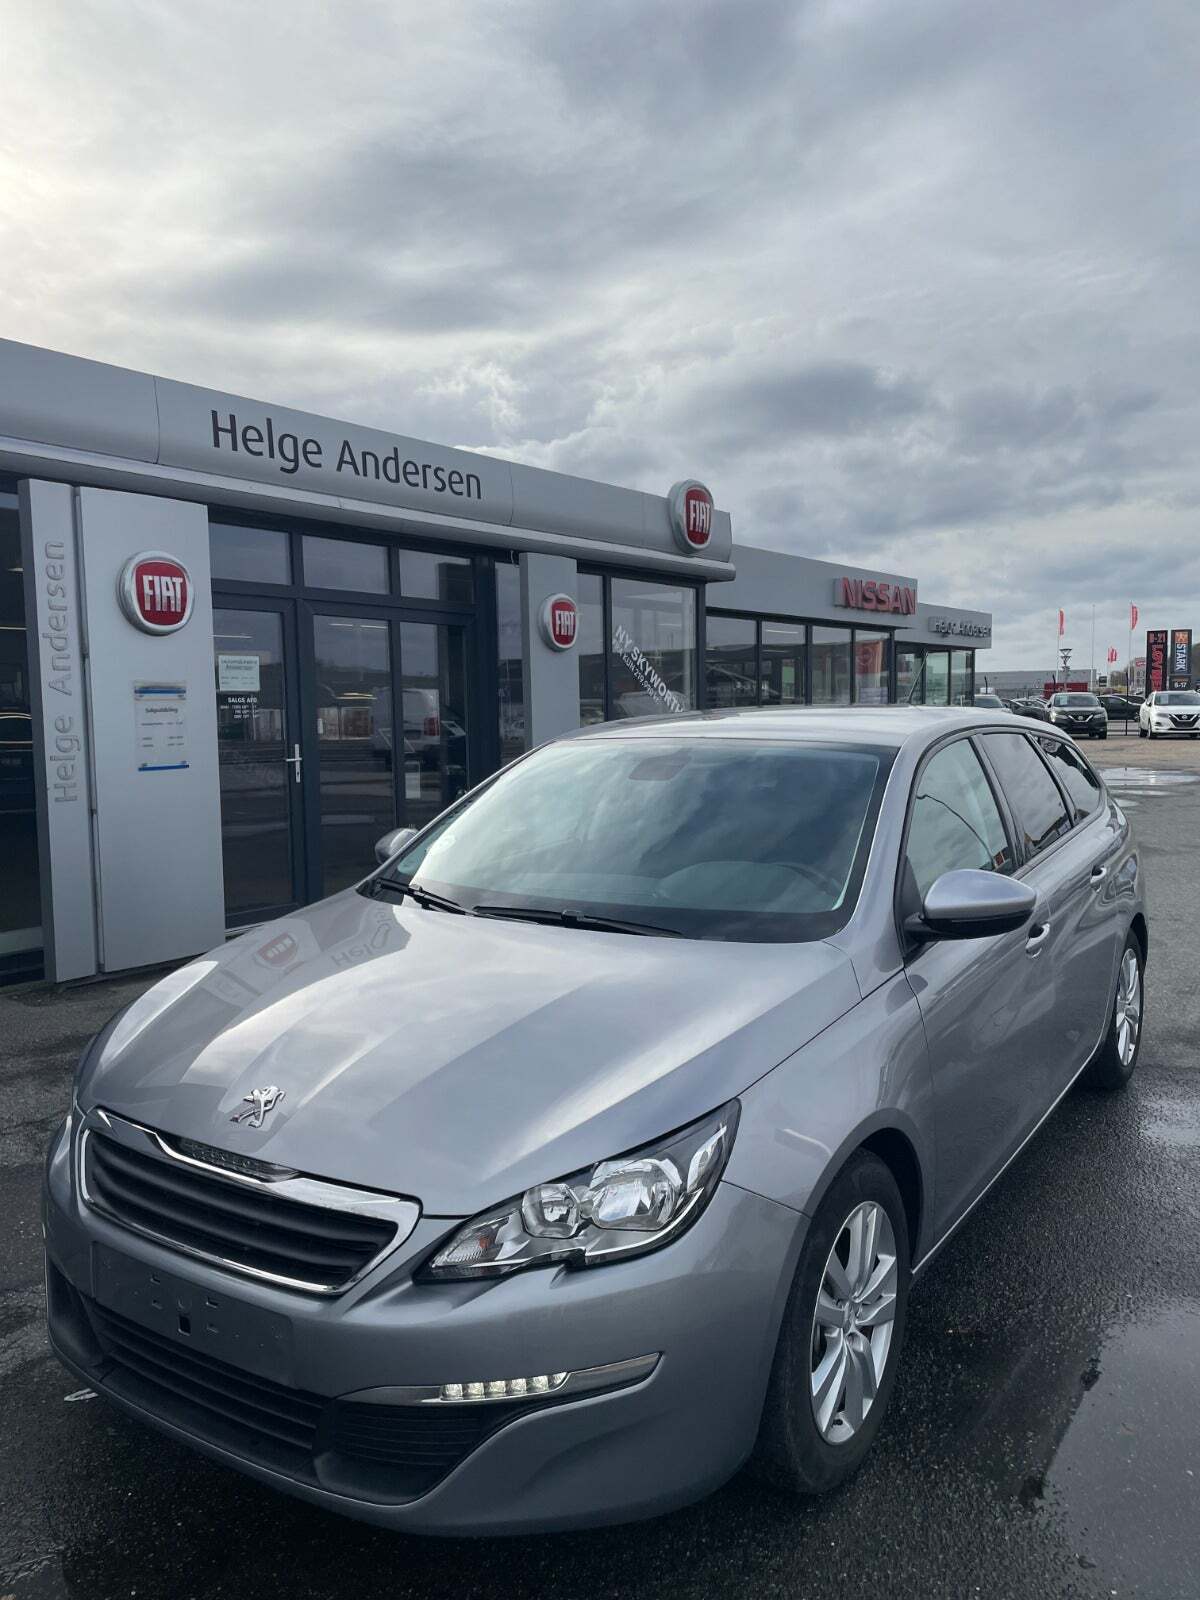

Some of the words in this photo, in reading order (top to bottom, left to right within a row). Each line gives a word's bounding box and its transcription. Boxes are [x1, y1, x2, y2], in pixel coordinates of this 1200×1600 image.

[210, 409, 322, 474] Helge
[336, 439, 482, 500] Andersen
[689, 499, 710, 534] FIAT
[142, 575, 183, 613] FIAT
[842, 576, 916, 616] NISSAN
[42, 541, 73, 697] Andersen
[555, 610, 575, 636] FIAT
[615, 625, 633, 649] NY
[1175, 643, 1187, 671] STARK
[50, 714, 81, 803] Helge
